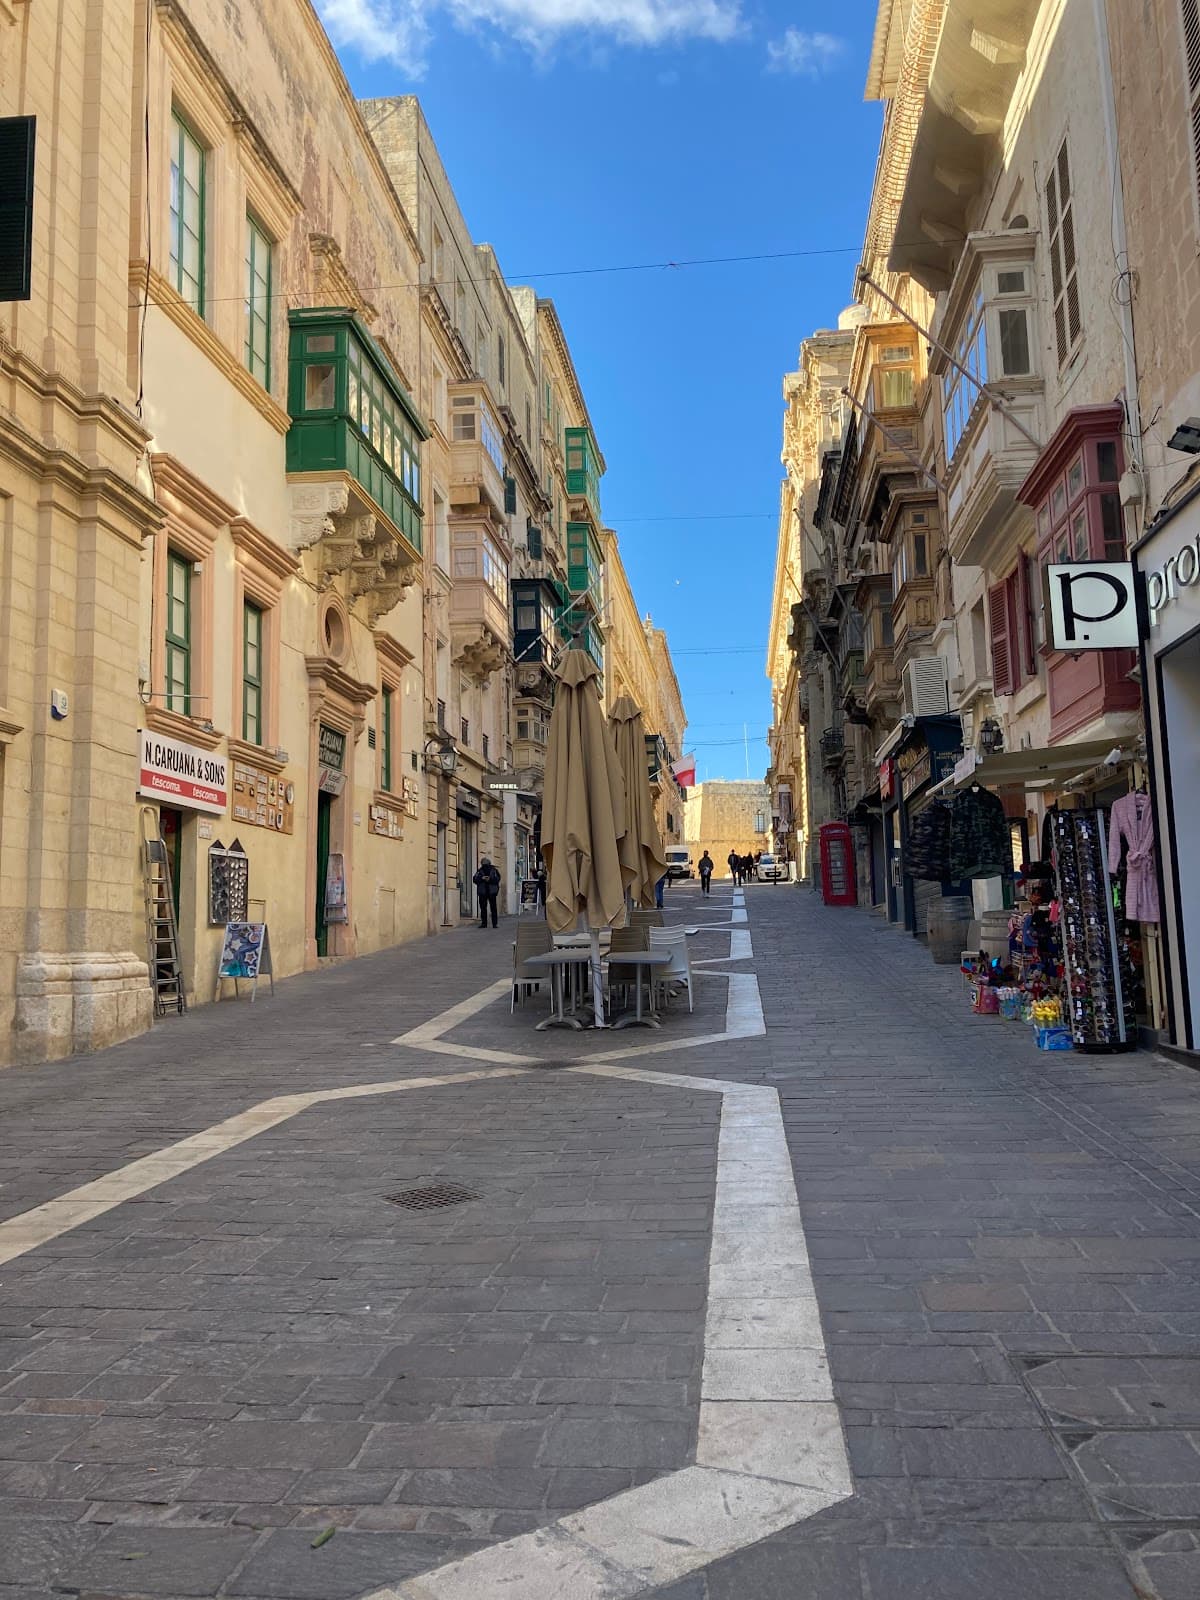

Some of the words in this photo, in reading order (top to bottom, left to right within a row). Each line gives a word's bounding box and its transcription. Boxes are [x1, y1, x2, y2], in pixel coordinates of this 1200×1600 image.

[1148, 533, 1200, 627] pro
[145, 740, 196, 778] N.CARUANA
[197, 757, 203, 779] &
[204, 760, 225, 786] SONS
